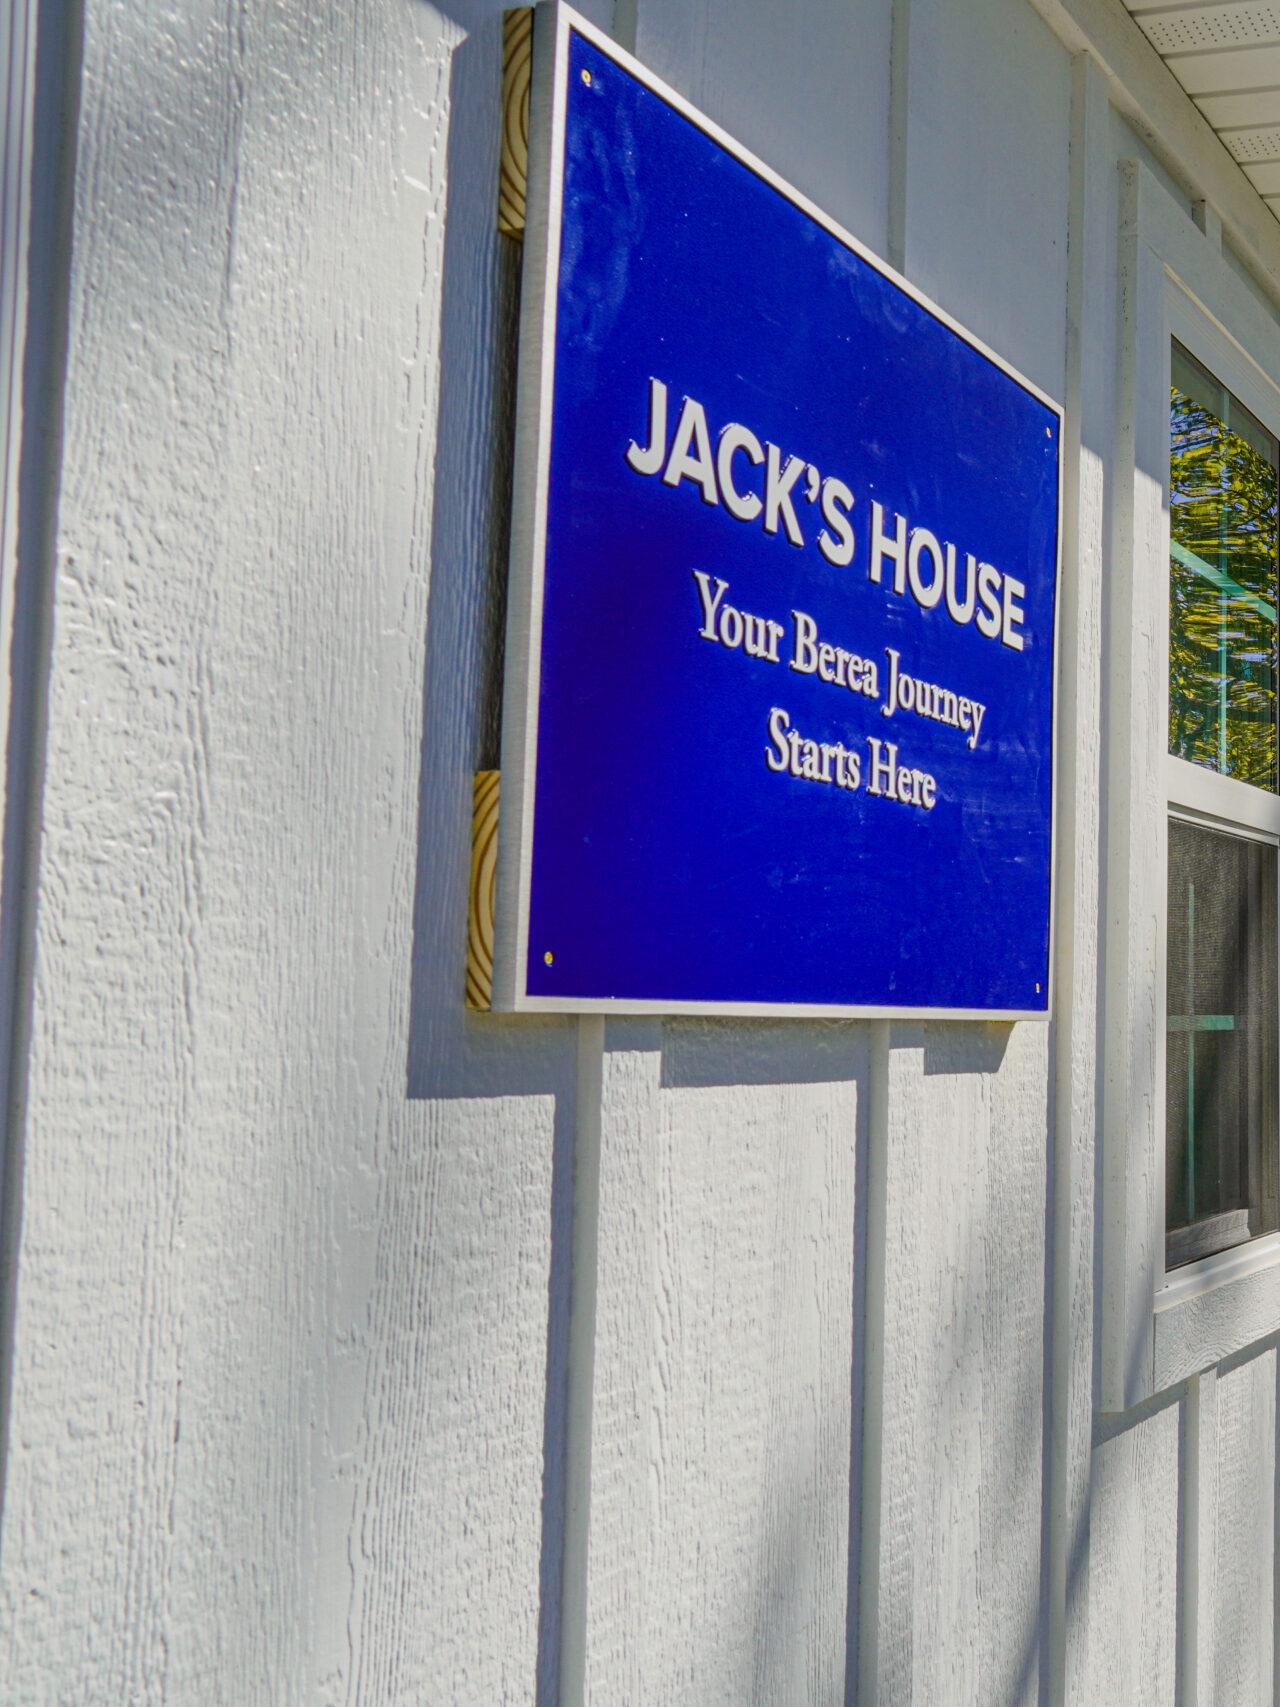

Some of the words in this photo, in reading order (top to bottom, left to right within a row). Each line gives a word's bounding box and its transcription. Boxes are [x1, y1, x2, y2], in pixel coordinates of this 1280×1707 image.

[627, 376, 855, 566] JACK'S
[870, 499, 1026, 651] HOUSE
[693, 569, 785, 663] Your
[790, 610, 880, 698] Berea
[881, 647, 986, 750] Journey
[766, 707, 860, 791] Starts
[866, 736, 937, 810] Here
